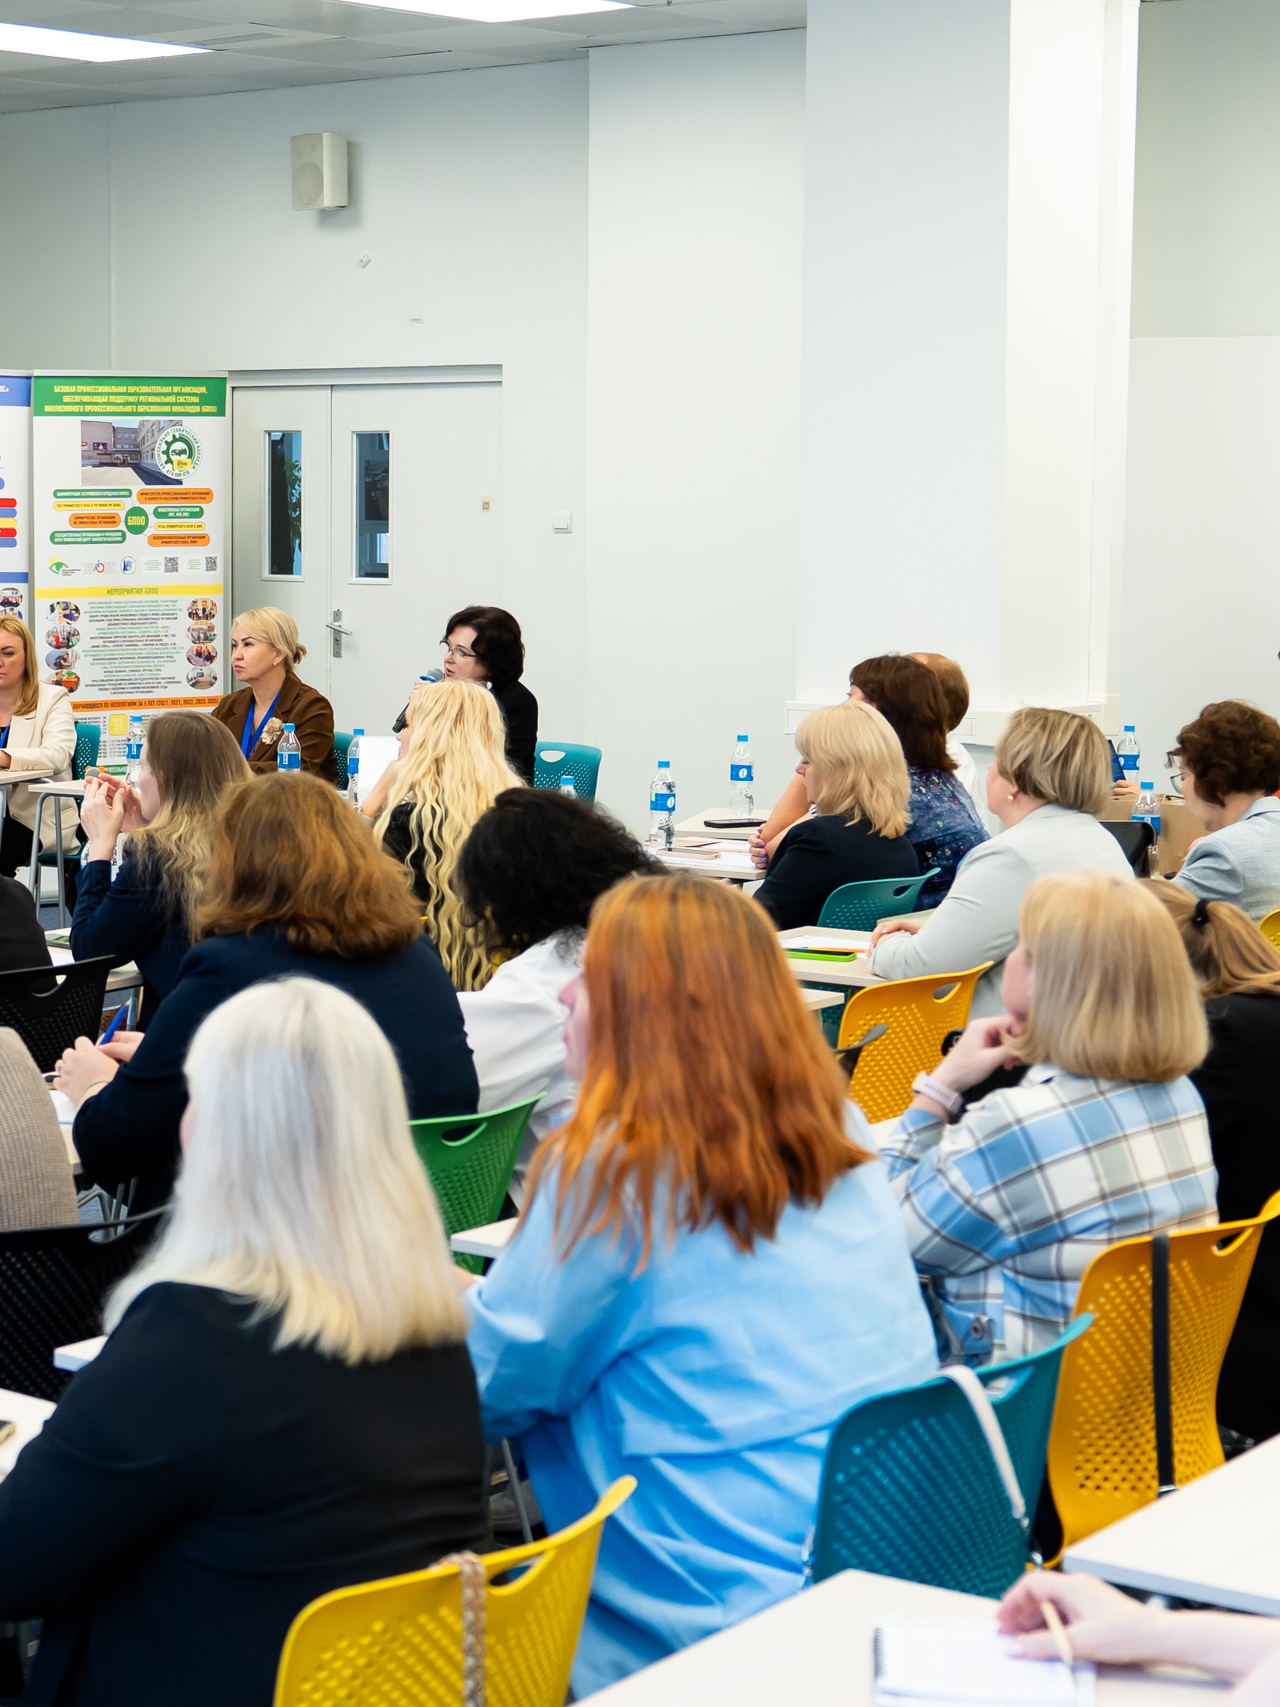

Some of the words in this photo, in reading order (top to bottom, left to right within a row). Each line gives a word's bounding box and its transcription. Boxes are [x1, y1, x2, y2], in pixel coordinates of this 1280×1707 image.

[53, 385, 76, 393] БАЗОВАЯ
[76, 385, 127, 393] ПРОФЕССИОНАЛЬНАЯ
[127, 385, 172, 393] ОБРАЗОВАТЕЛЬНАЯ
[62, 395, 109, 403] ОБЕСПЕЧИВАЮЩАЯ
[109, 395, 139, 403] ПОДДЕРЖКУ
[139, 394, 176, 403] РЕГИОНАЛЬНОЙ
[176, 395, 200, 403] СИСТЕМЫ
[136, 405, 171, 413] ОБРАЗОВАНИЯ
[171, 405, 201, 414] ИНВАЛИДОВ
[127, 515, 146, 526] БПОО
[106, 587, 143, 596] МЕРОПРИЯТИЯ
[144, 587, 159, 595] БПОО
